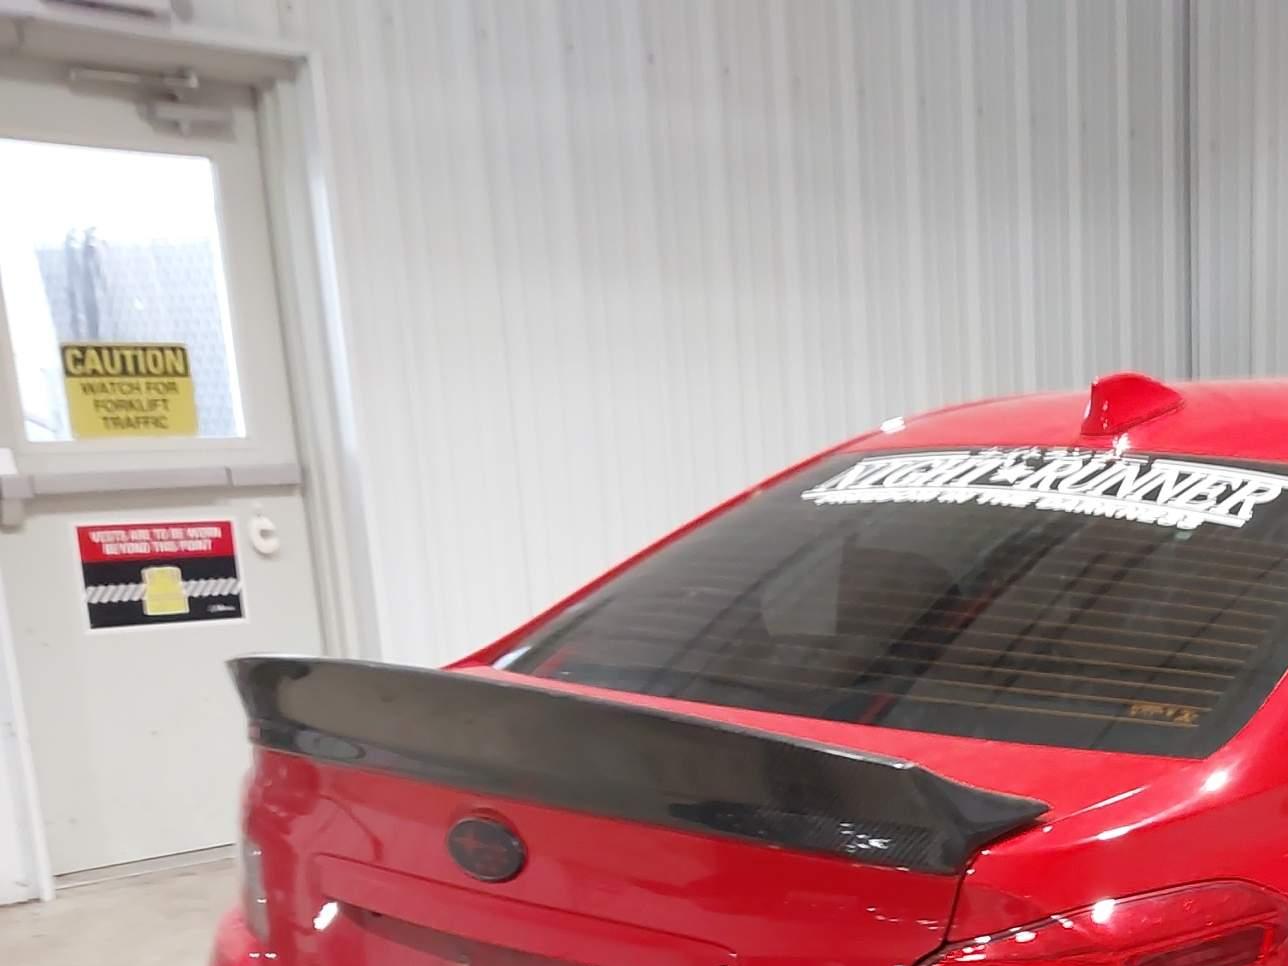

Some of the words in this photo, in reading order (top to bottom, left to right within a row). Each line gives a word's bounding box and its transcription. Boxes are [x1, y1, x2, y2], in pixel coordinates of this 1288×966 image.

[64, 347, 186, 376] CAUTION
[80, 381, 142, 395] WATCH
[144, 380, 179, 395] FOR
[92, 397, 170, 413] FORKLIFT
[102, 415, 170, 430] TRAFFIC
[815, 455, 1006, 490] NIGHT
[1011, 456, 1283, 519] RUNNER
